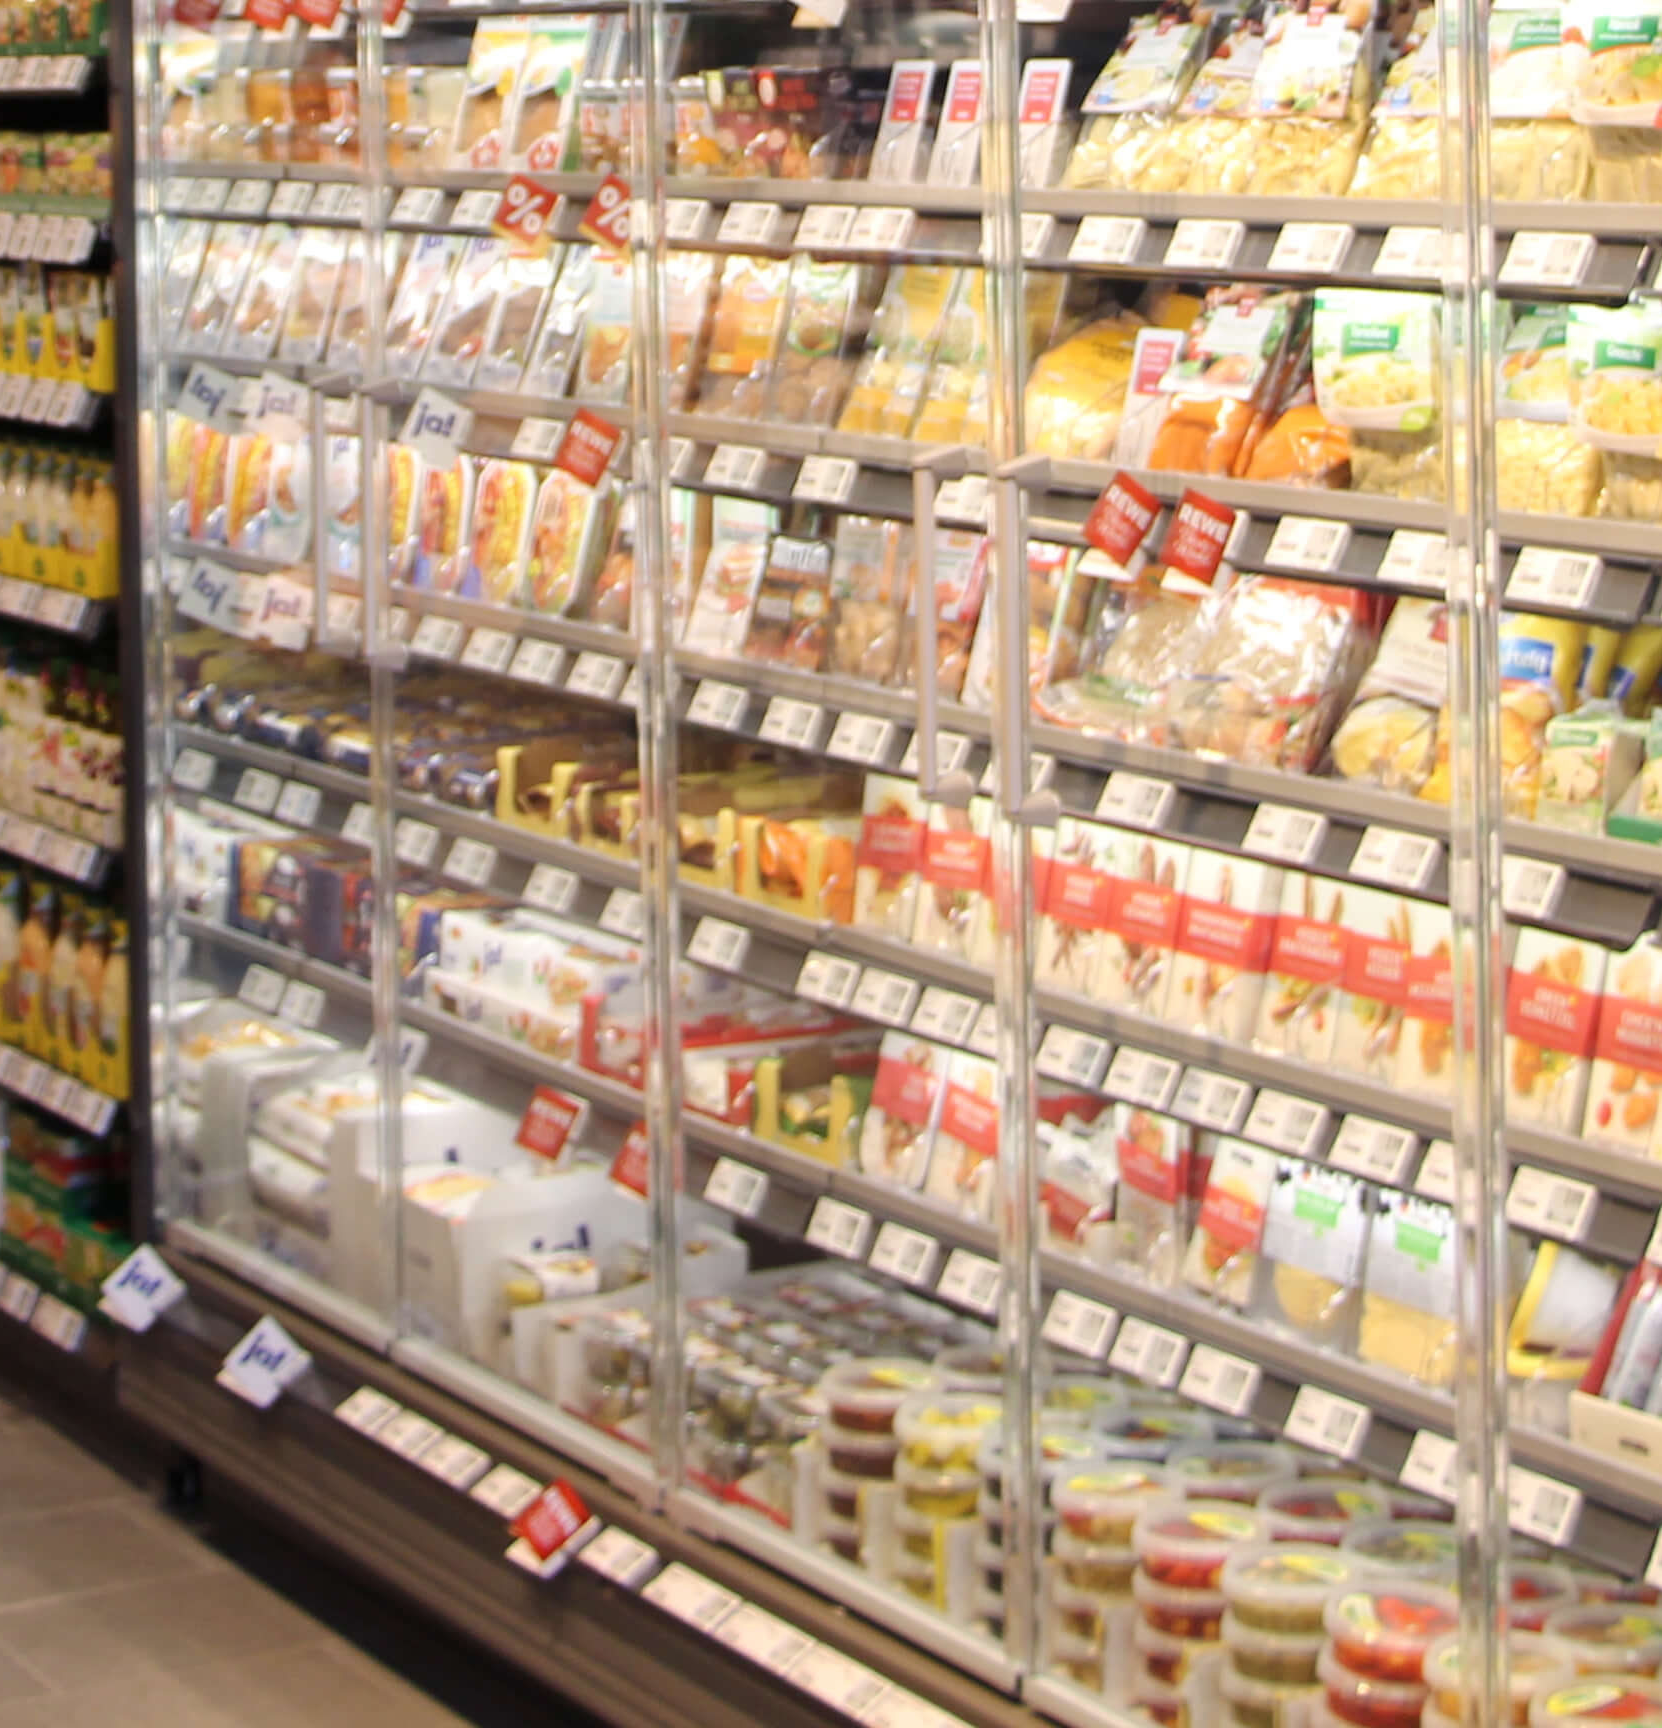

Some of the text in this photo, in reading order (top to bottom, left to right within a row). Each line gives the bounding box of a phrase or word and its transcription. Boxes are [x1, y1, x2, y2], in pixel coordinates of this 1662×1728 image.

[258, 385, 298, 418] ja!
[413, 402, 456, 438] ja!
[1105, 482, 1151, 532] REWE
[1177, 499, 1231, 545] REWE
[260, 587, 302, 622] ja!
[241, 1332, 286, 1371] ja!
